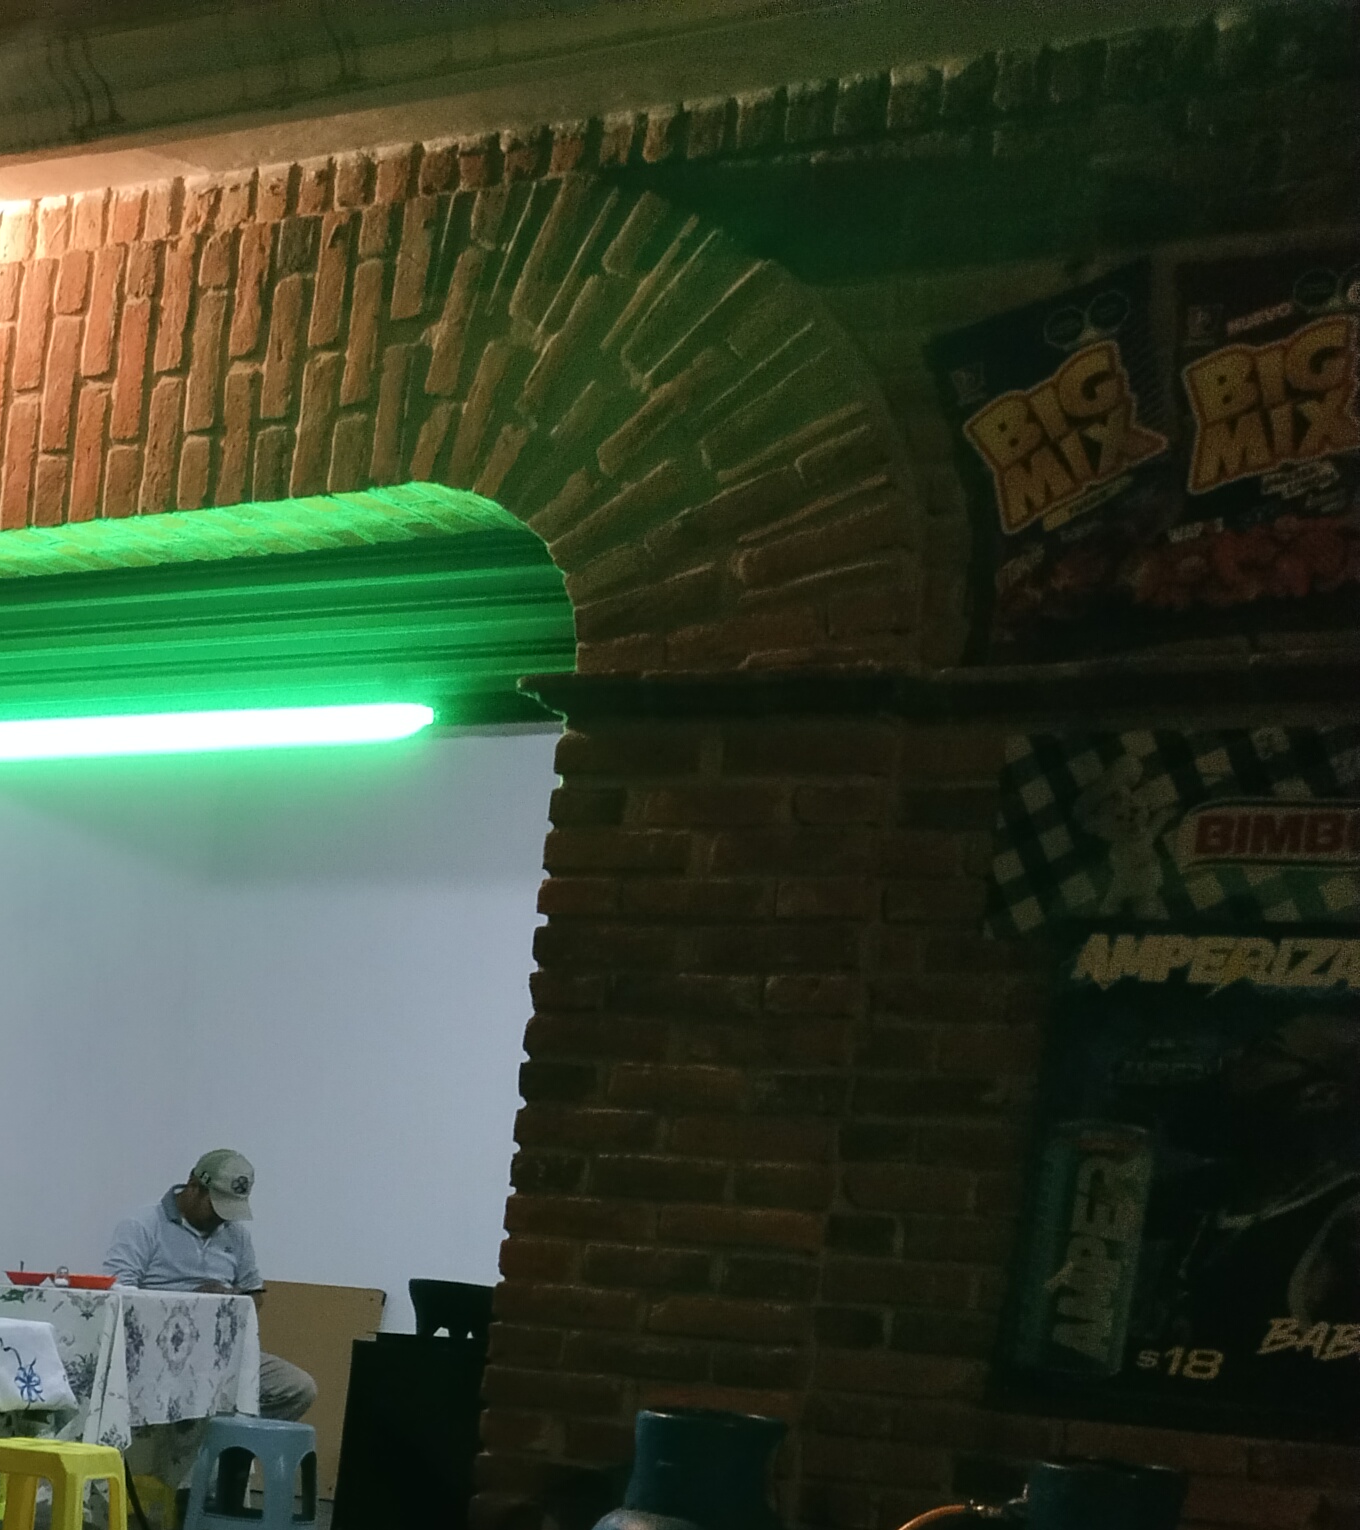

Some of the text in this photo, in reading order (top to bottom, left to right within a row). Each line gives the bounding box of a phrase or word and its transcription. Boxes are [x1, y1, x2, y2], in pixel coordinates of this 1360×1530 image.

[966, 342, 1120, 470] BIG
[1187, 315, 1353, 422] BIG
[998, 404, 1166, 532] MIX
[1190, 388, 1360, 491] MIX
